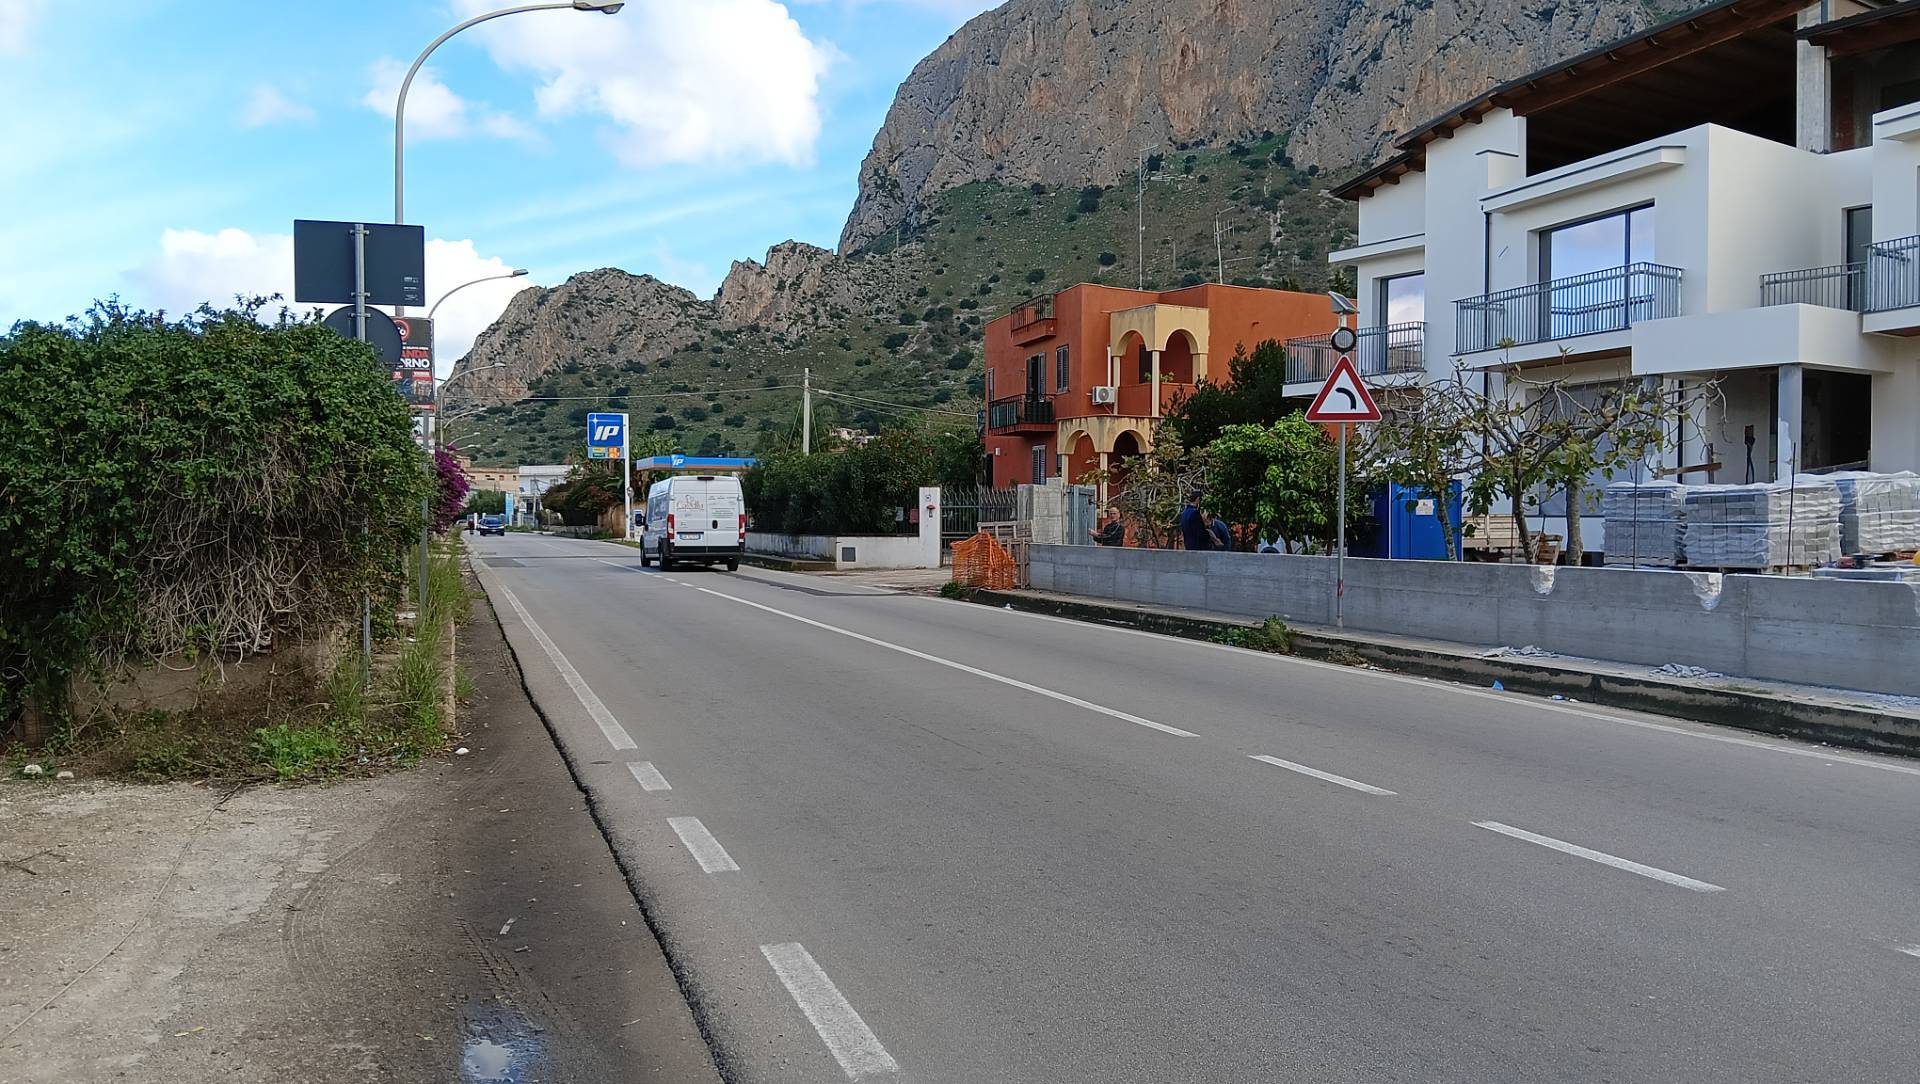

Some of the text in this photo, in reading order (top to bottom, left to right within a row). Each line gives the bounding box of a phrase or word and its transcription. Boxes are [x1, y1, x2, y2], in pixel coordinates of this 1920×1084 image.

[401, 350, 428, 358] ANDA
[398, 358, 430, 368] ORNO
[594, 426, 620, 440] IP
